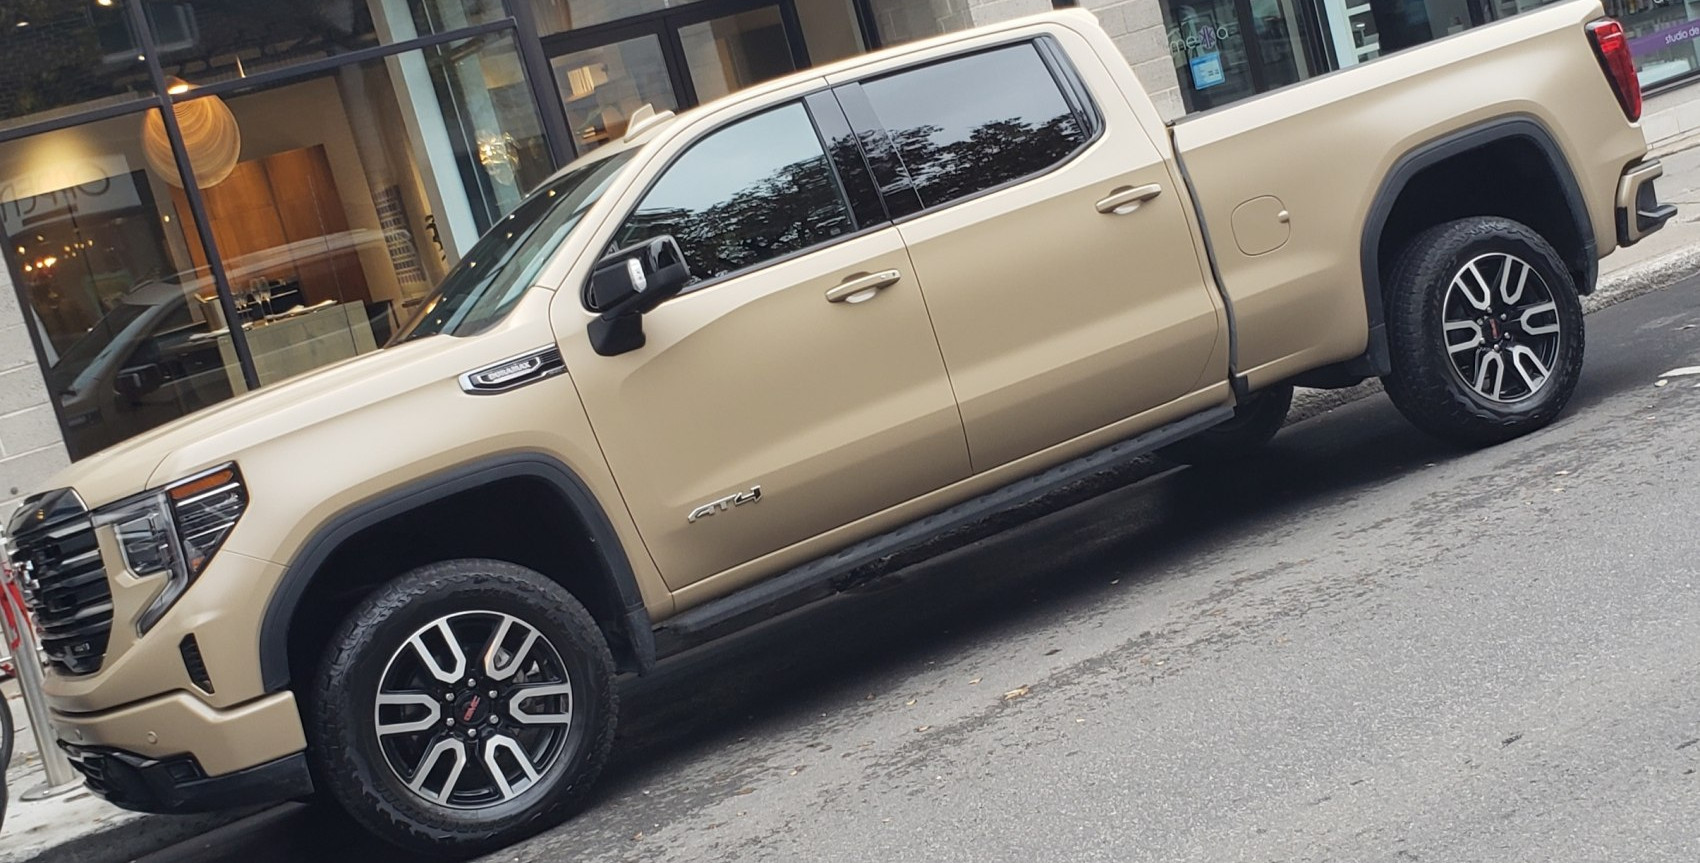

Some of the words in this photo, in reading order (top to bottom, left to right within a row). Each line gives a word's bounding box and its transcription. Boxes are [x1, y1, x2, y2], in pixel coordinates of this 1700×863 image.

[1665, 30, 1688, 44] studio
[487, 361, 531, 380] DURAMAX
[687, 484, 762, 523] AT4
[463, 695, 480, 721] GMC
